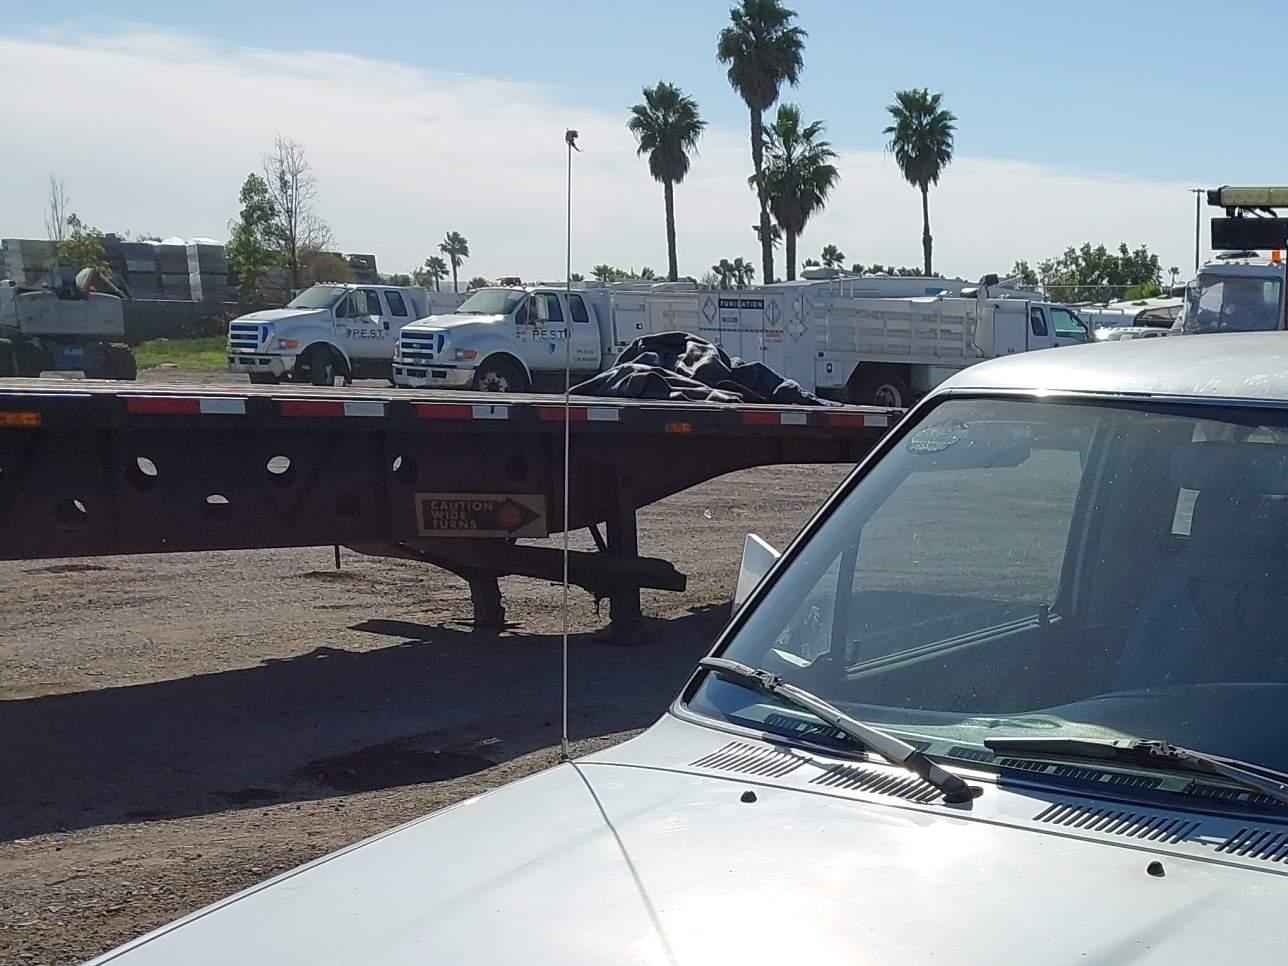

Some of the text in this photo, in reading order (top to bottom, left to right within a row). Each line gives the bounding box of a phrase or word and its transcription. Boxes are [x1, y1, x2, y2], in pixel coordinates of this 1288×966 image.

[720, 300, 763, 308] FUMIGATION
[430, 501, 493, 510] CAUTION
[431, 510, 466, 519] WIDE
[433, 519, 477, 529] TURNS
